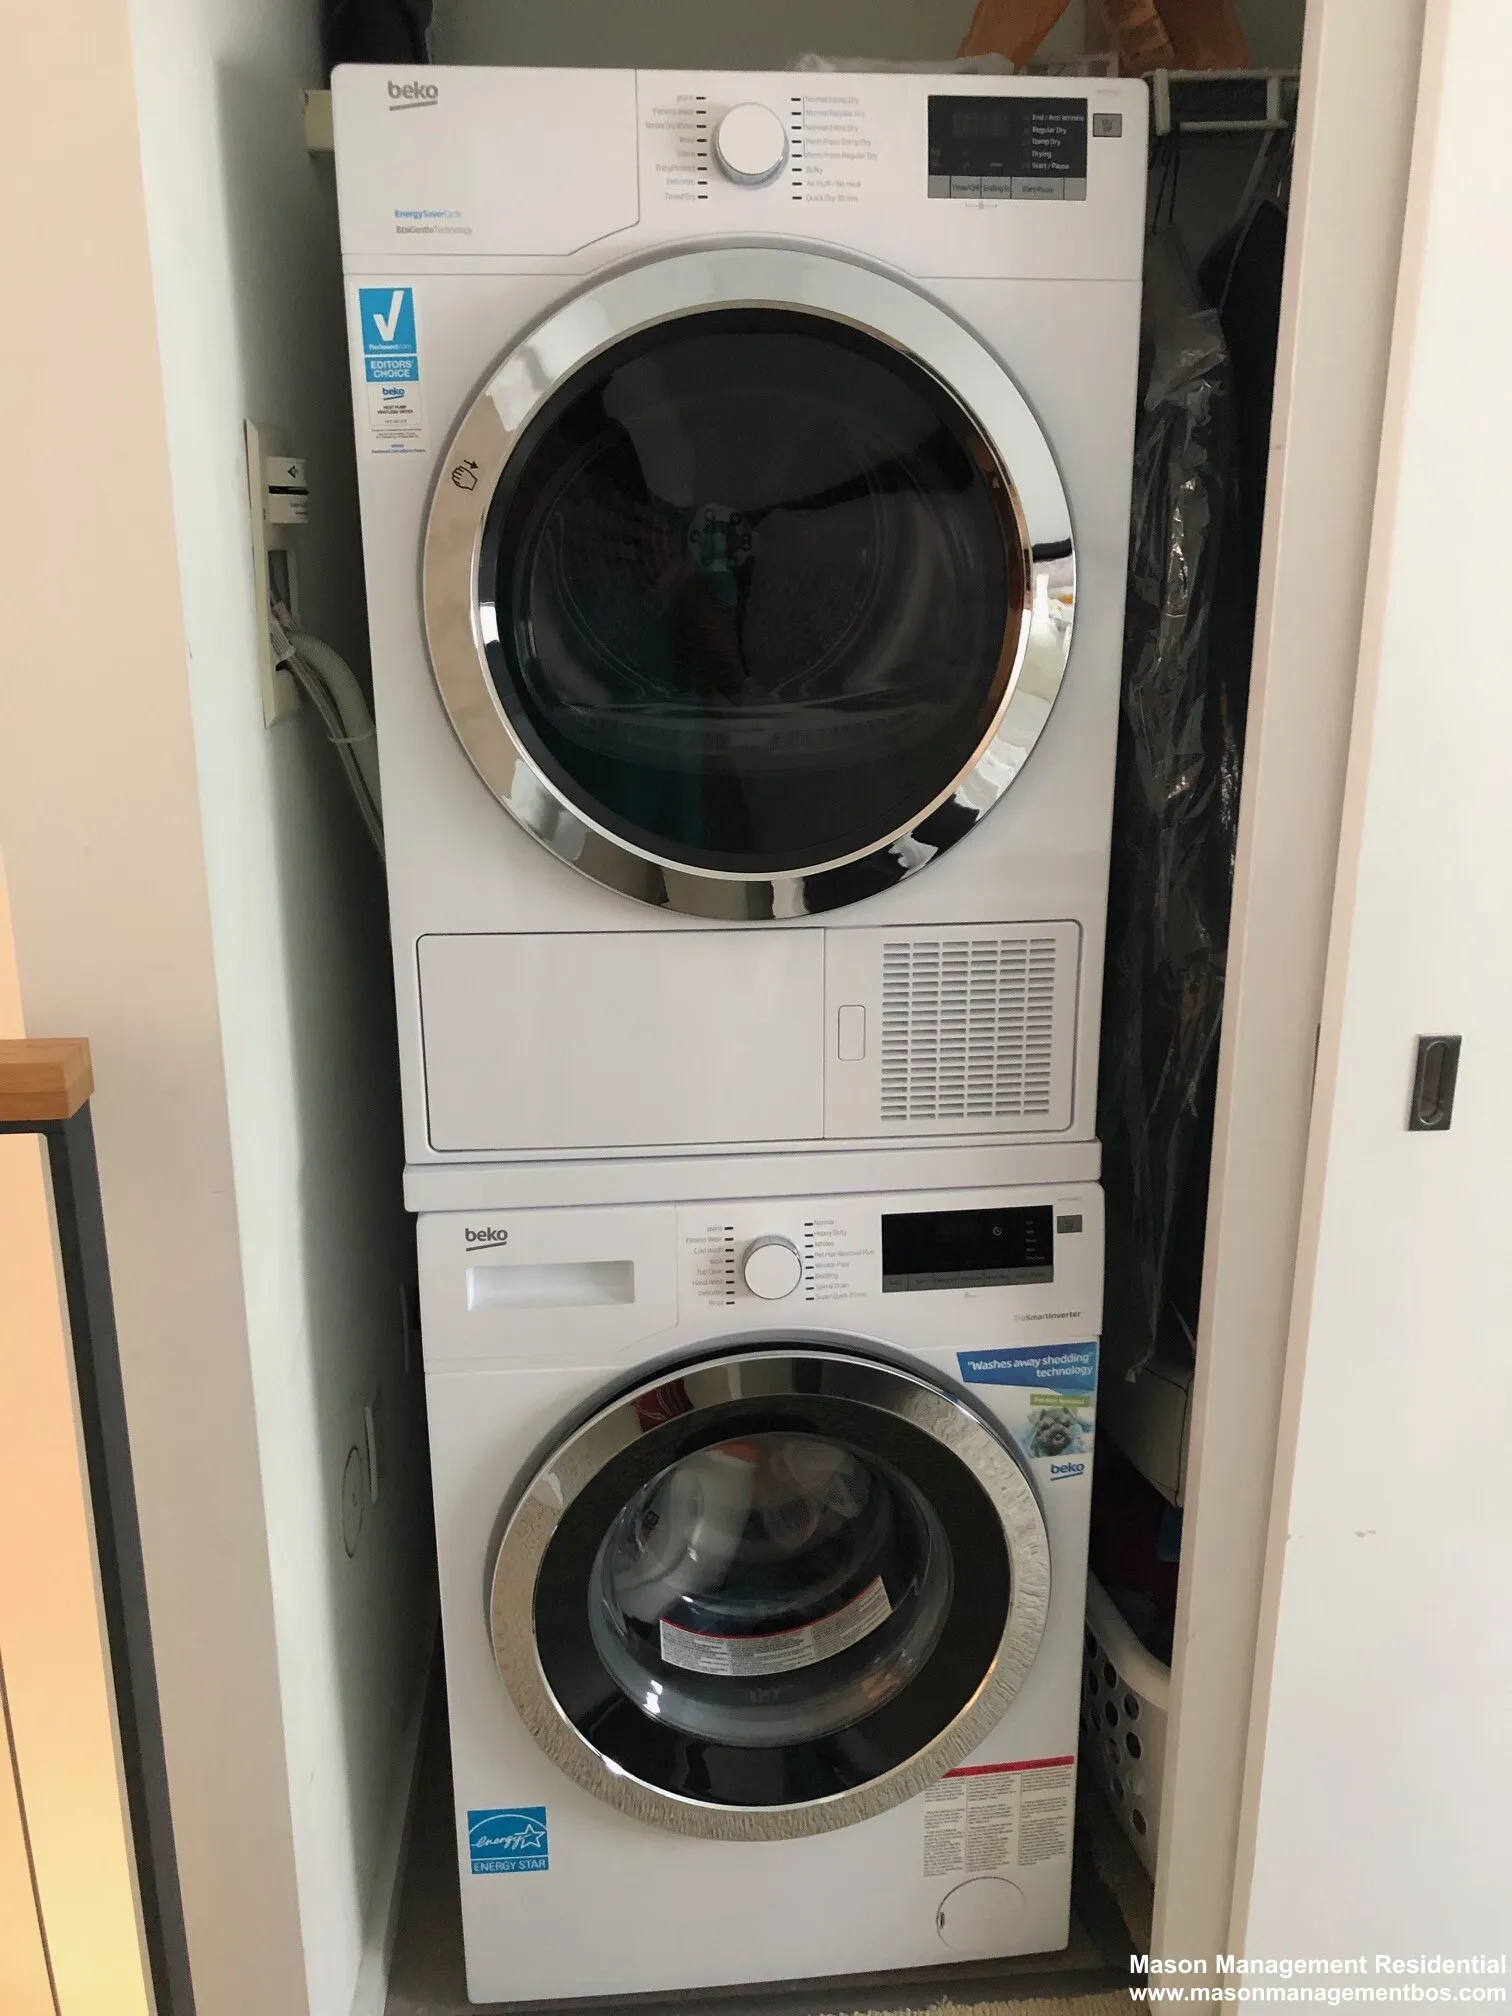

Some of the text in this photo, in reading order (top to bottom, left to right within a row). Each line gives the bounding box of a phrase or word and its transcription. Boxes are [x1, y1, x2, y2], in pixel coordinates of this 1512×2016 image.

[387, 80, 439, 99] beko
[1055, 126, 1067, 135] Dry
[1050, 138, 1061, 147] Dry
[374, 369, 410, 378] CHOICE
[382, 387, 405, 396] beko
[465, 1227, 508, 1242] beko
[1013, 1311, 1081, 1321] ProSmartInverter
[1013, 1357, 1042, 1368] away
[1036, 1365, 1093, 1378] technology
[1051, 1462, 1085, 1475] beko
[471, 1833, 527, 1850] energy
[474, 1859, 546, 1872] ENERGY STAR
